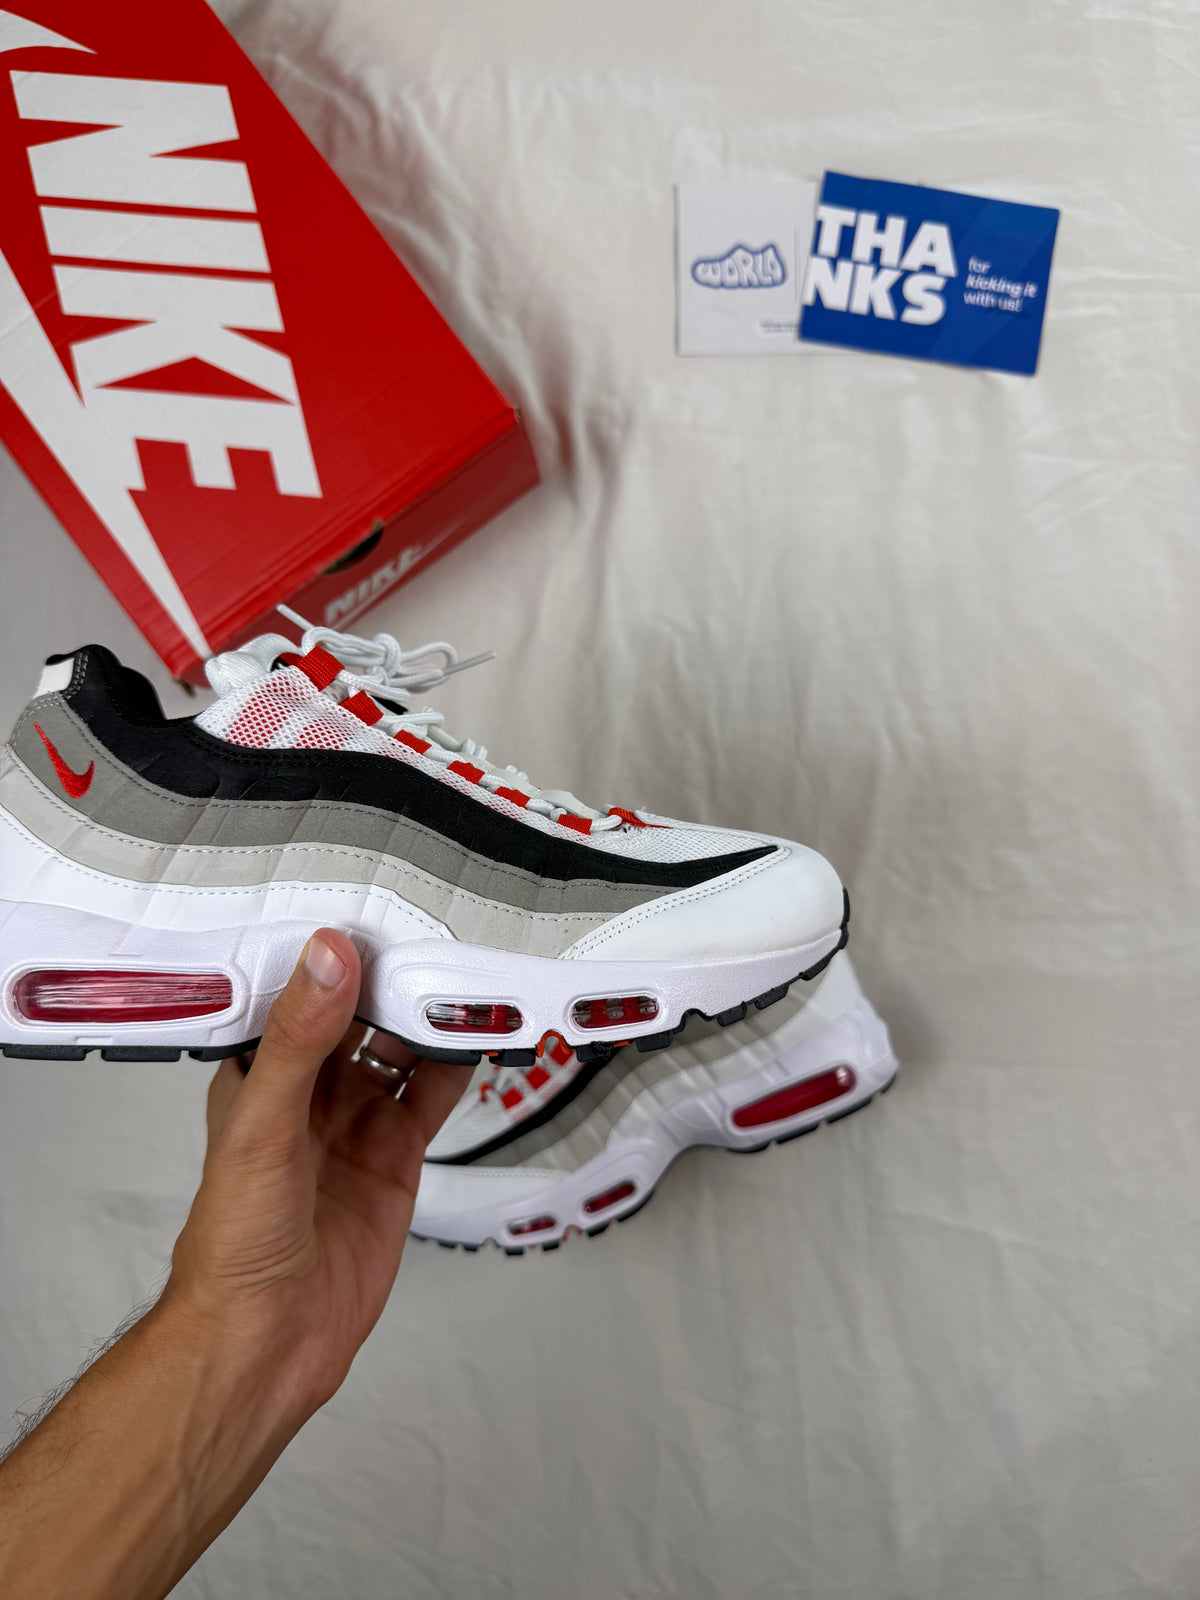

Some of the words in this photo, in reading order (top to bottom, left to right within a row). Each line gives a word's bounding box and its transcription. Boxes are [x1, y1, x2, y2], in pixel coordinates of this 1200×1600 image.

[817, 204, 958, 278] THA
[968, 256, 991, 273] for
[9, 70, 323, 498] NIKE
[803, 257, 948, 326] NKS
[963, 292, 996, 308] with
[998, 297, 1023, 312] us!
[965, 274, 1023, 298] kicking
[1024, 282, 1037, 298] it
[323, 543, 426, 623] NIKE
